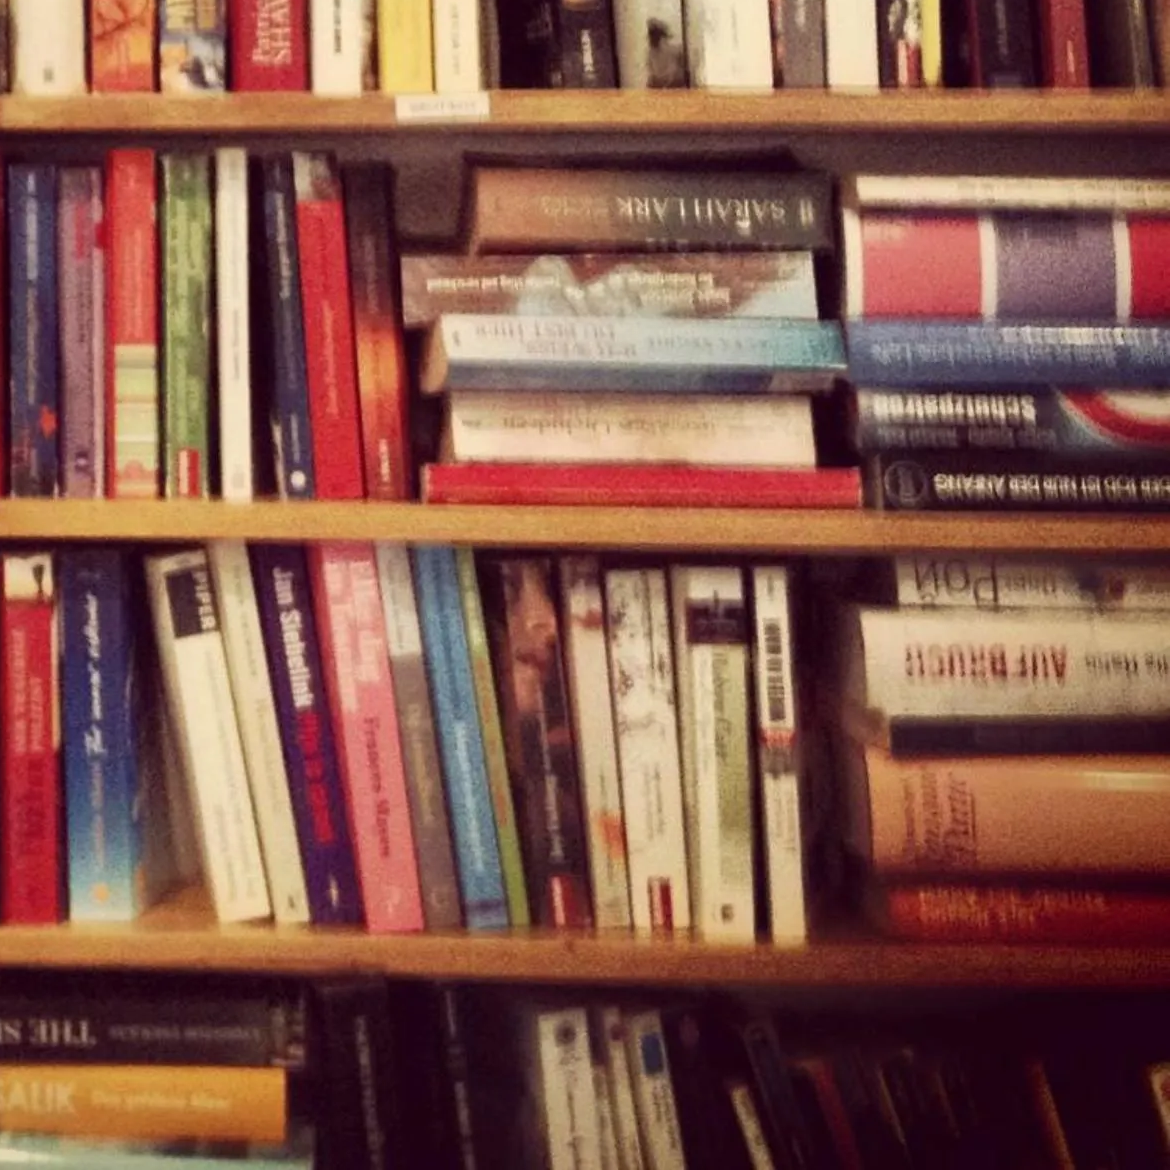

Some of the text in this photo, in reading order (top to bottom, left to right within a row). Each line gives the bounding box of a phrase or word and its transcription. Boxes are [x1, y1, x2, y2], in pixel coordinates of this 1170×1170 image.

[616, 196, 786, 221] SARAH LARK
[934, 473, 1008, 502] ANFANG
[1009, 473, 1040, 501] DER
[1043, 473, 1076, 501] NUR
[1079, 474, 1100, 500] IST
[272, 567, 296, 604] Jan
[193, 571, 216, 629] PIPER
[30, 1018, 97, 1047] THE
